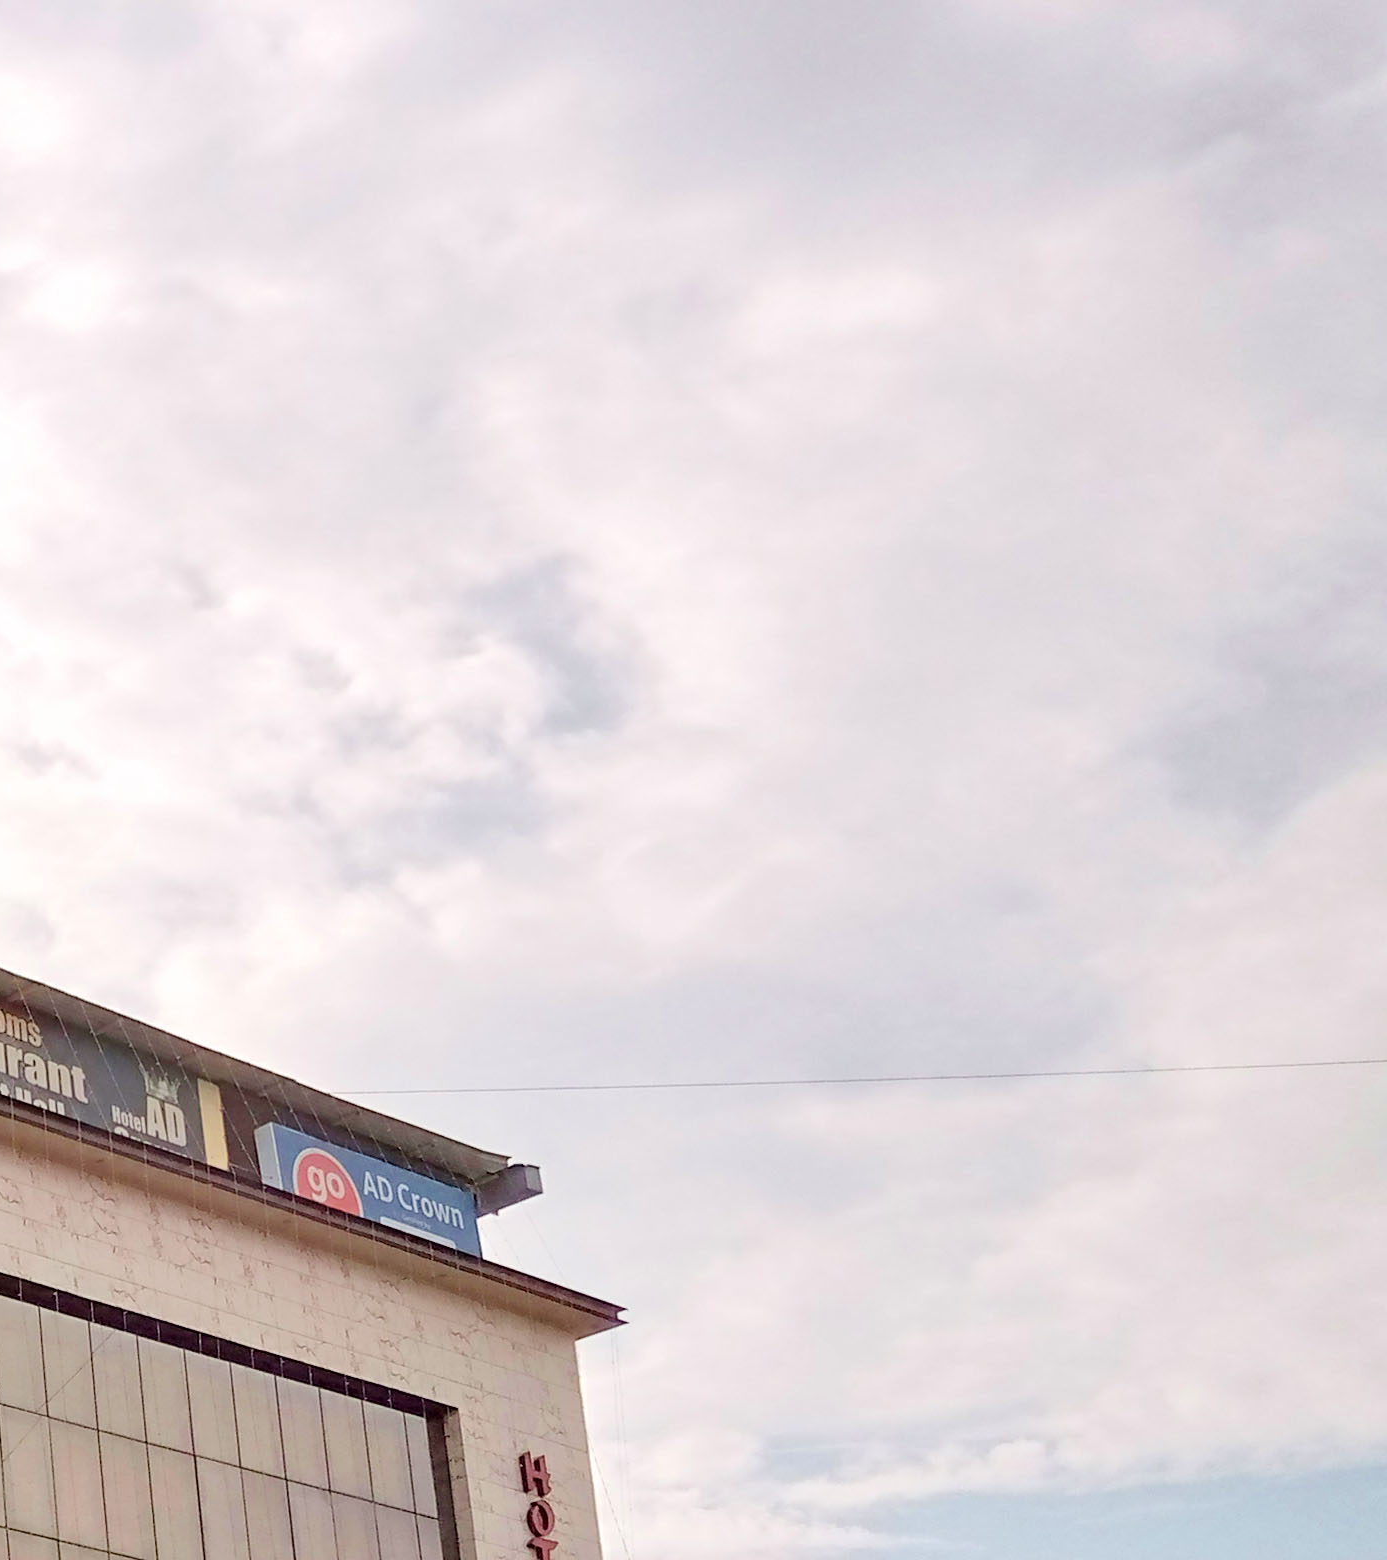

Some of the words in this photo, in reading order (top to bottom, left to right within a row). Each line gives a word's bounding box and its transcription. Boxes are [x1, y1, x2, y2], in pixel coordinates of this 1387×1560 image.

[111, 1104, 146, 1134] Hotel
[146, 1094, 187, 1148] AD
[306, 1165, 346, 1201] go
[363, 1170, 394, 1203] AD
[397, 1182, 465, 1230] Crown
